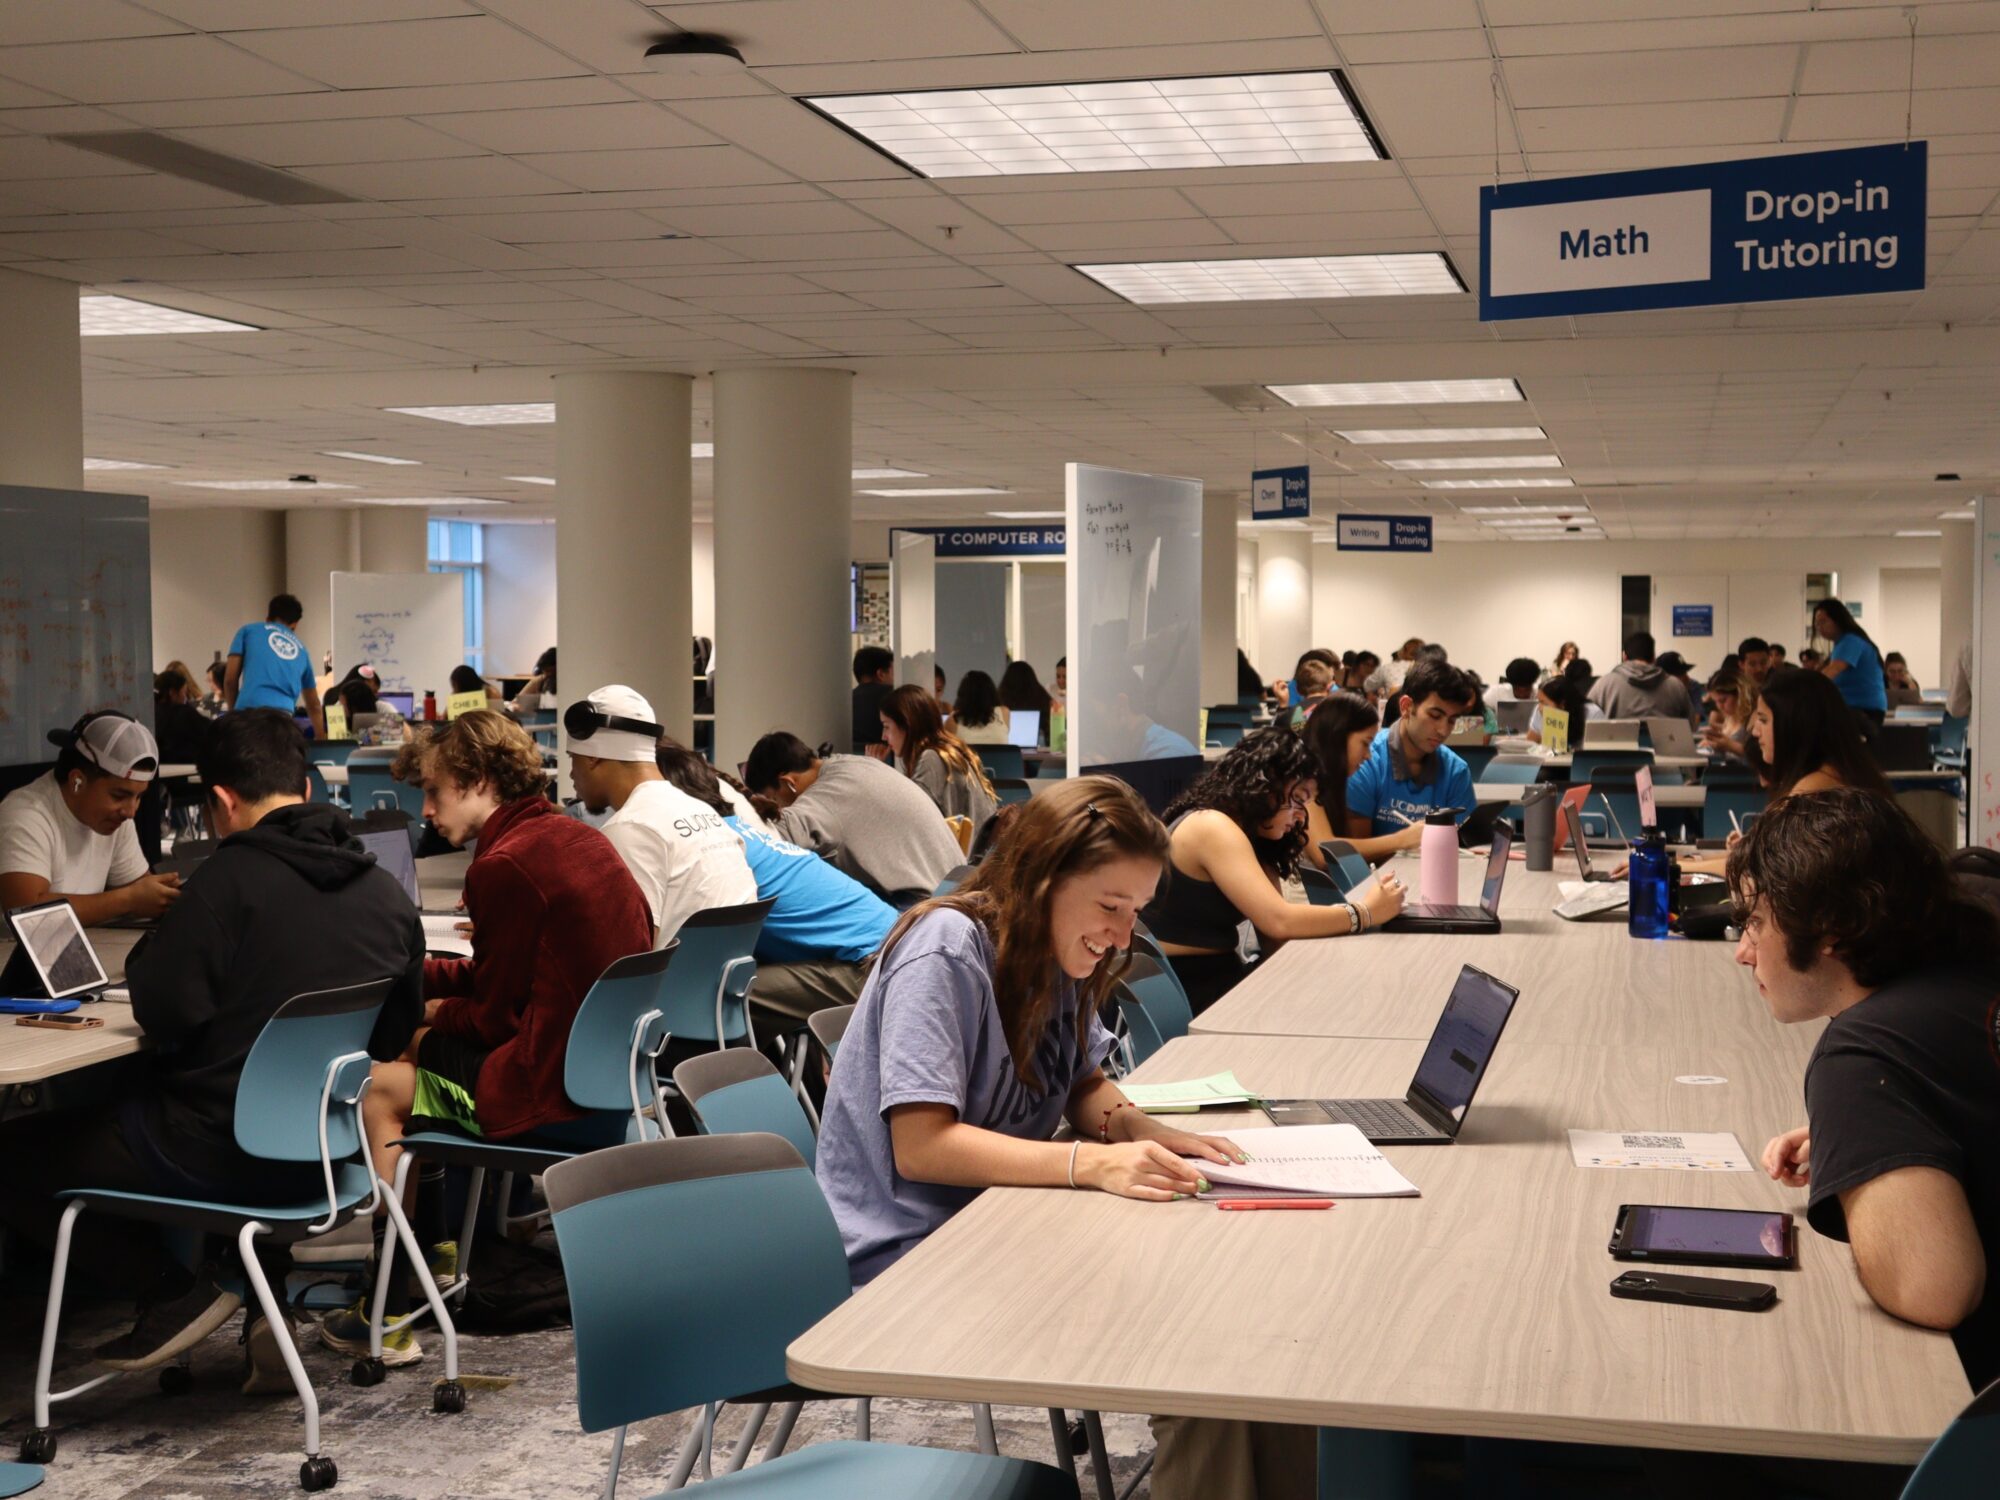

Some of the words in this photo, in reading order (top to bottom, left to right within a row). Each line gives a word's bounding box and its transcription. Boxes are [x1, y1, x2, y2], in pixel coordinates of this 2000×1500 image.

[1745, 180, 1889, 224] Drop-in
[1560, 225, 1649, 260] Math
[1735, 231, 1899, 272] Tutoring
[1286, 478, 1306, 491] Drop-in
[1285, 495, 1307, 509] Tutoring
[1350, 528, 1380, 539] Writing
[1396, 522, 1426, 534] Drop-in
[951, 532, 1038, 545] COMPUTER
[1044, 531, 1066, 544] RO
[1395, 535, 1428, 547] Tutoring
